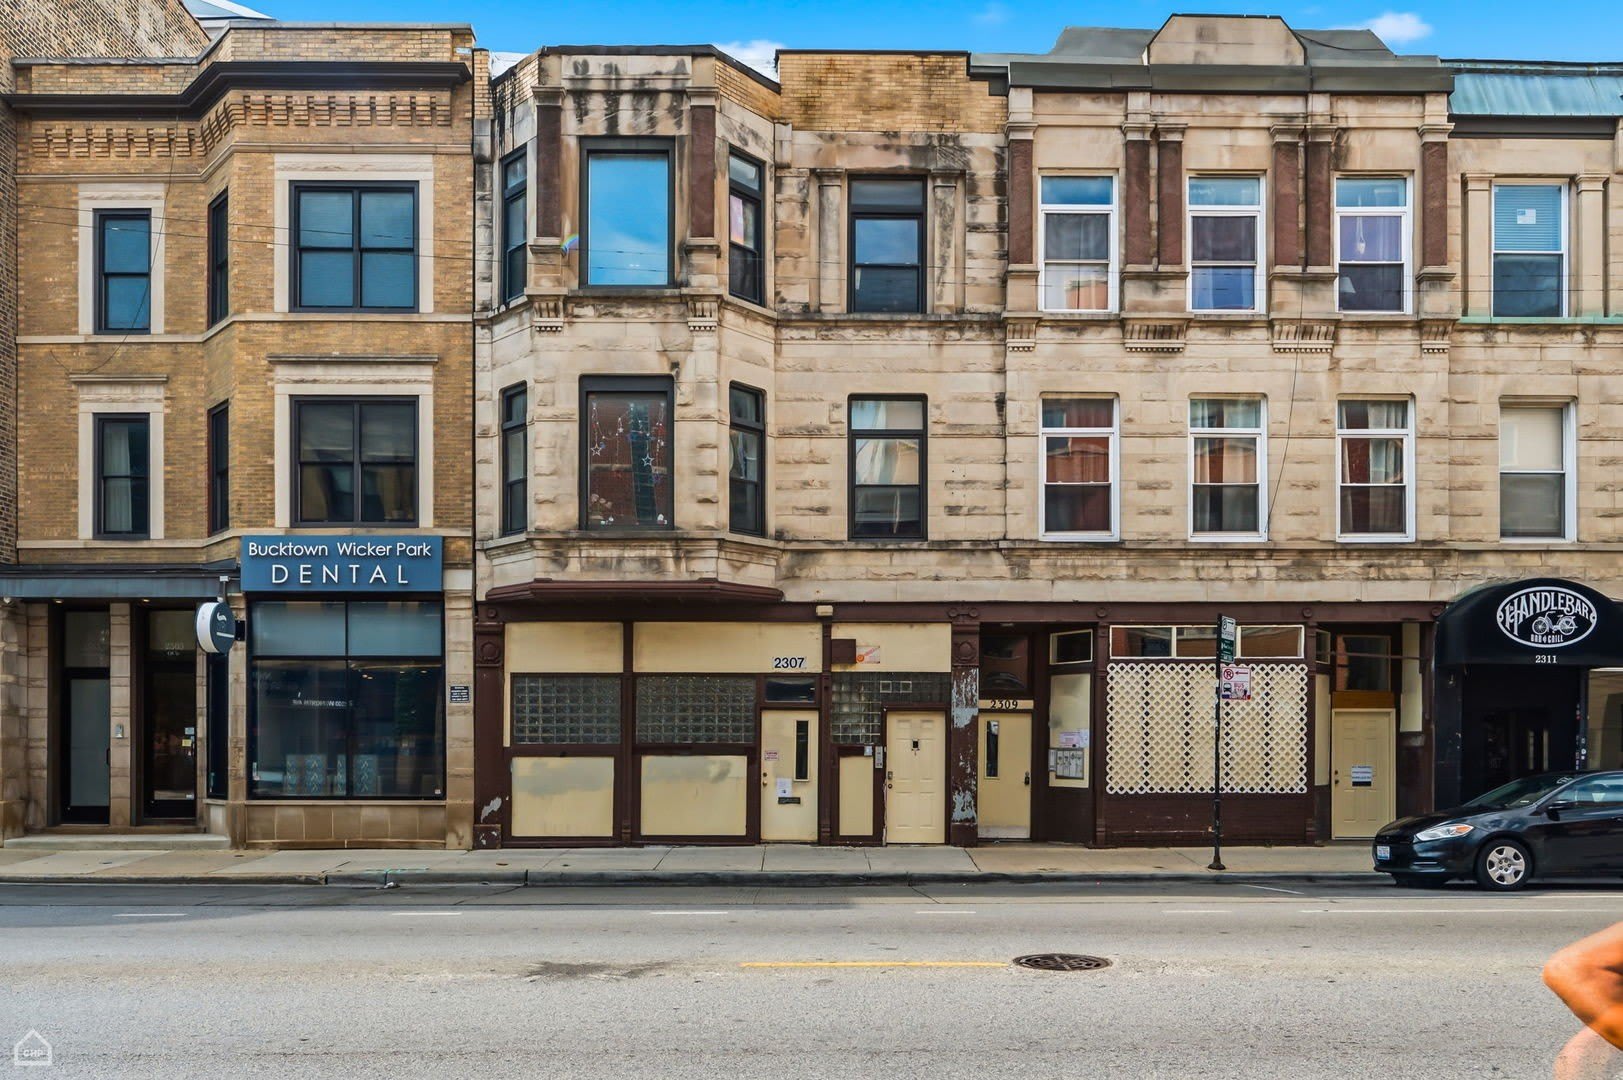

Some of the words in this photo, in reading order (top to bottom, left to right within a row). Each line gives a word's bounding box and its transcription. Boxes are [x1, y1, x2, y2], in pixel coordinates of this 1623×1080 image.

[248, 542, 328, 557] Bucktown
[337, 542, 392, 557] Wicker
[396, 542, 432, 557] Park
[271, 564, 409, 584] DENTAL
[1547, 634, 1564, 644] GRILL
[774, 657, 805, 669] 2307
[1535, 654, 1558, 664] 2311
[990, 699, 1018, 710] 2309
